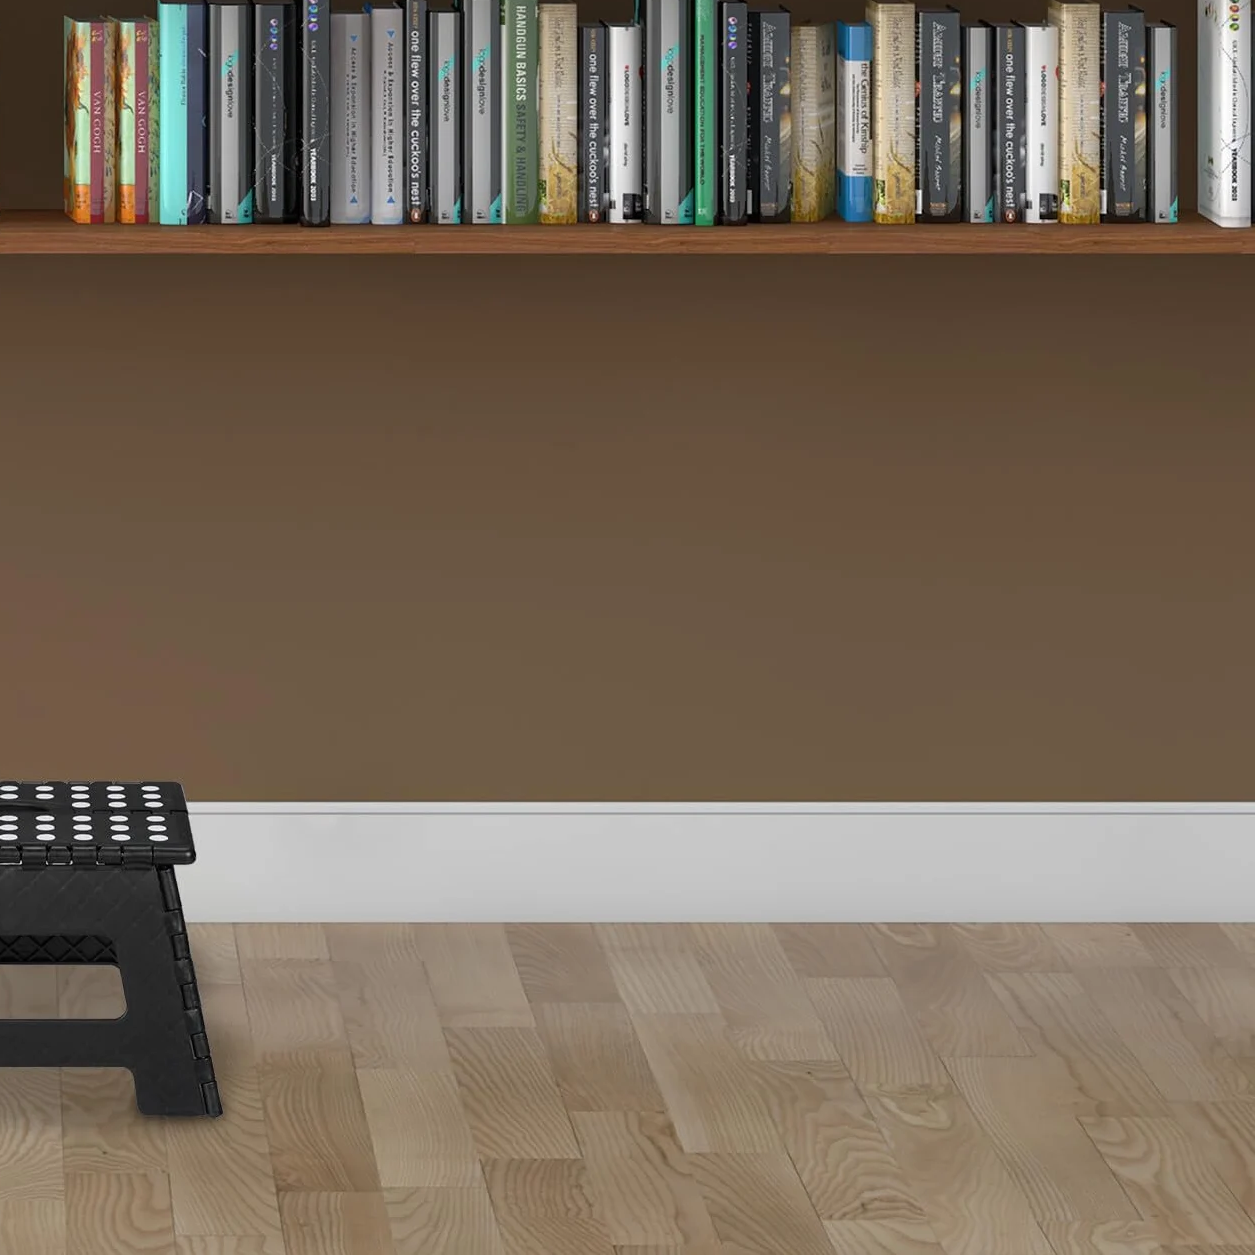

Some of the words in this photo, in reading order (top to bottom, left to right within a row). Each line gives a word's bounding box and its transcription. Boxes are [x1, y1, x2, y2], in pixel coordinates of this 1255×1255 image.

[516, 6, 526, 59] HANDGUN
[516, 62, 526, 101] BASICS
[861, 63, 870, 76] the
[93, 91, 101, 114] VAN
[138, 91, 146, 115] VAN
[861, 79, 870, 107] Genius
[516, 104, 527, 143] SAFETY
[861, 110, 870, 119] of
[93, 118, 101, 153] GOGH
[138, 118, 146, 153] GOGH
[859, 122, 870, 153] Kinship
[515, 157, 527, 213] HANDLING
